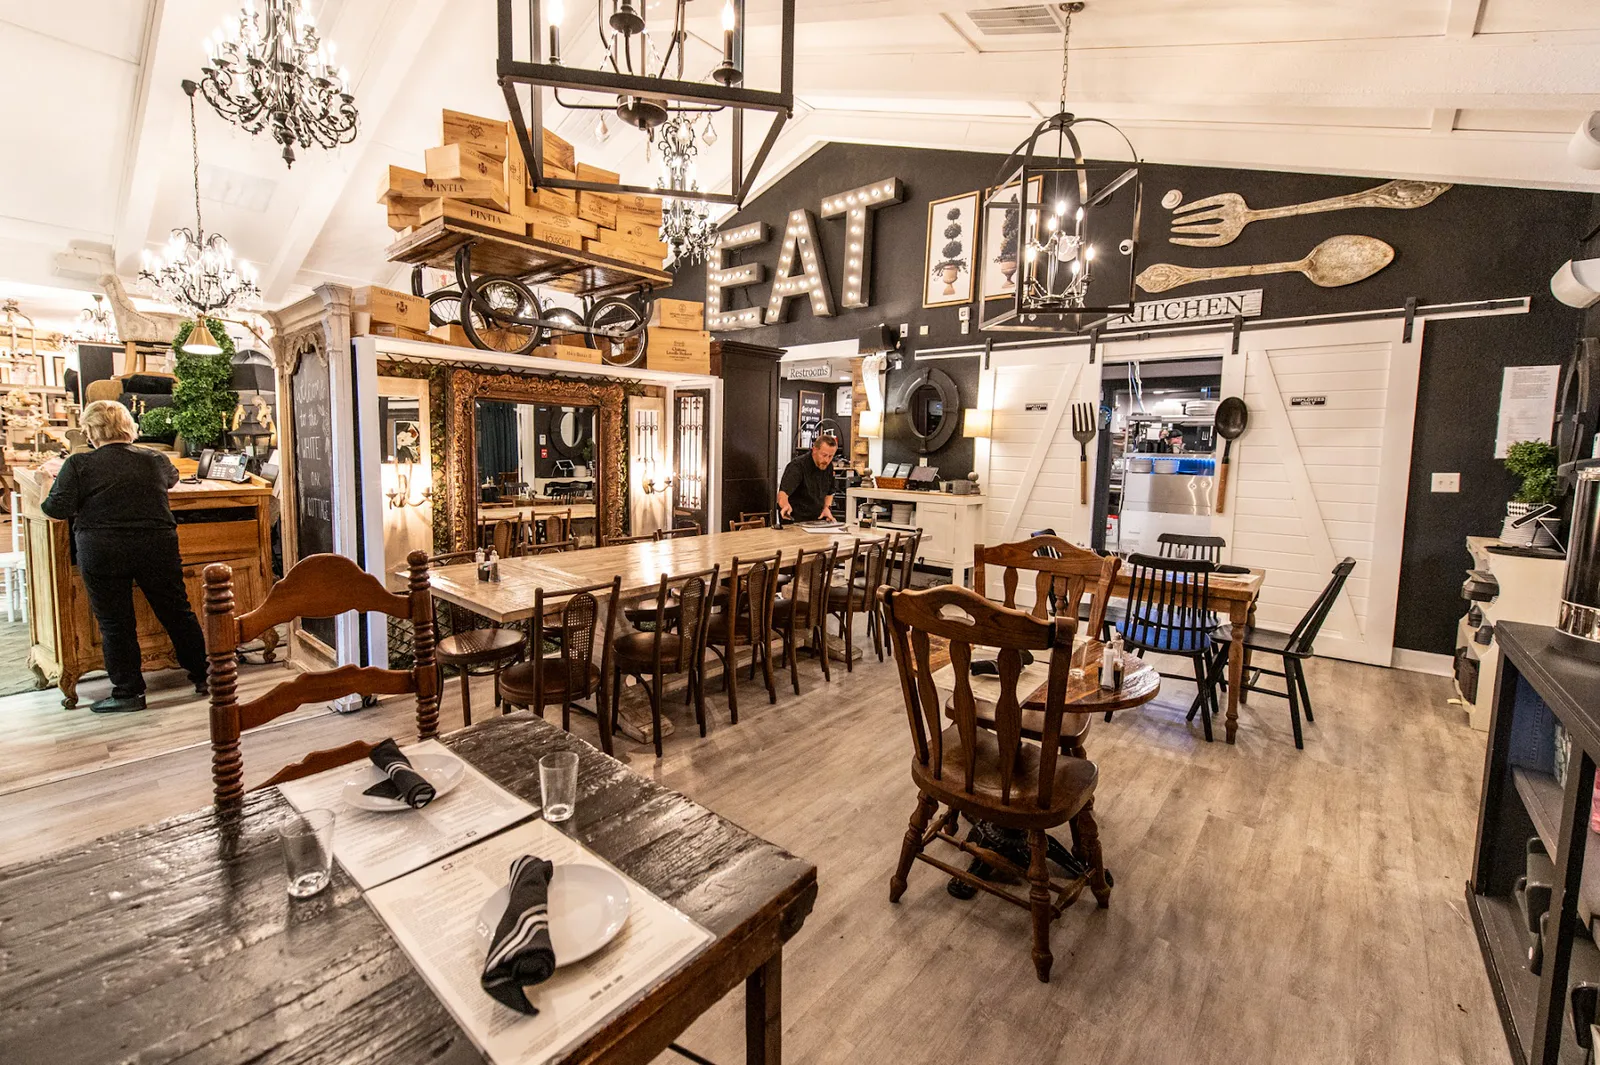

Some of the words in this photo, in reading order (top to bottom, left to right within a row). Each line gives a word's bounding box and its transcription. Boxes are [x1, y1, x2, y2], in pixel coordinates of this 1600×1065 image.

[430, 183, 464, 193] PINTIA
[470, 209, 502, 224] PINTIA
[705, 177, 904, 331] EAT
[380, 289, 394, 298] CLOS
[790, 367, 828, 378] Restrooms
[302, 436, 322, 460] WHITE
[310, 471, 321, 487] OAK
